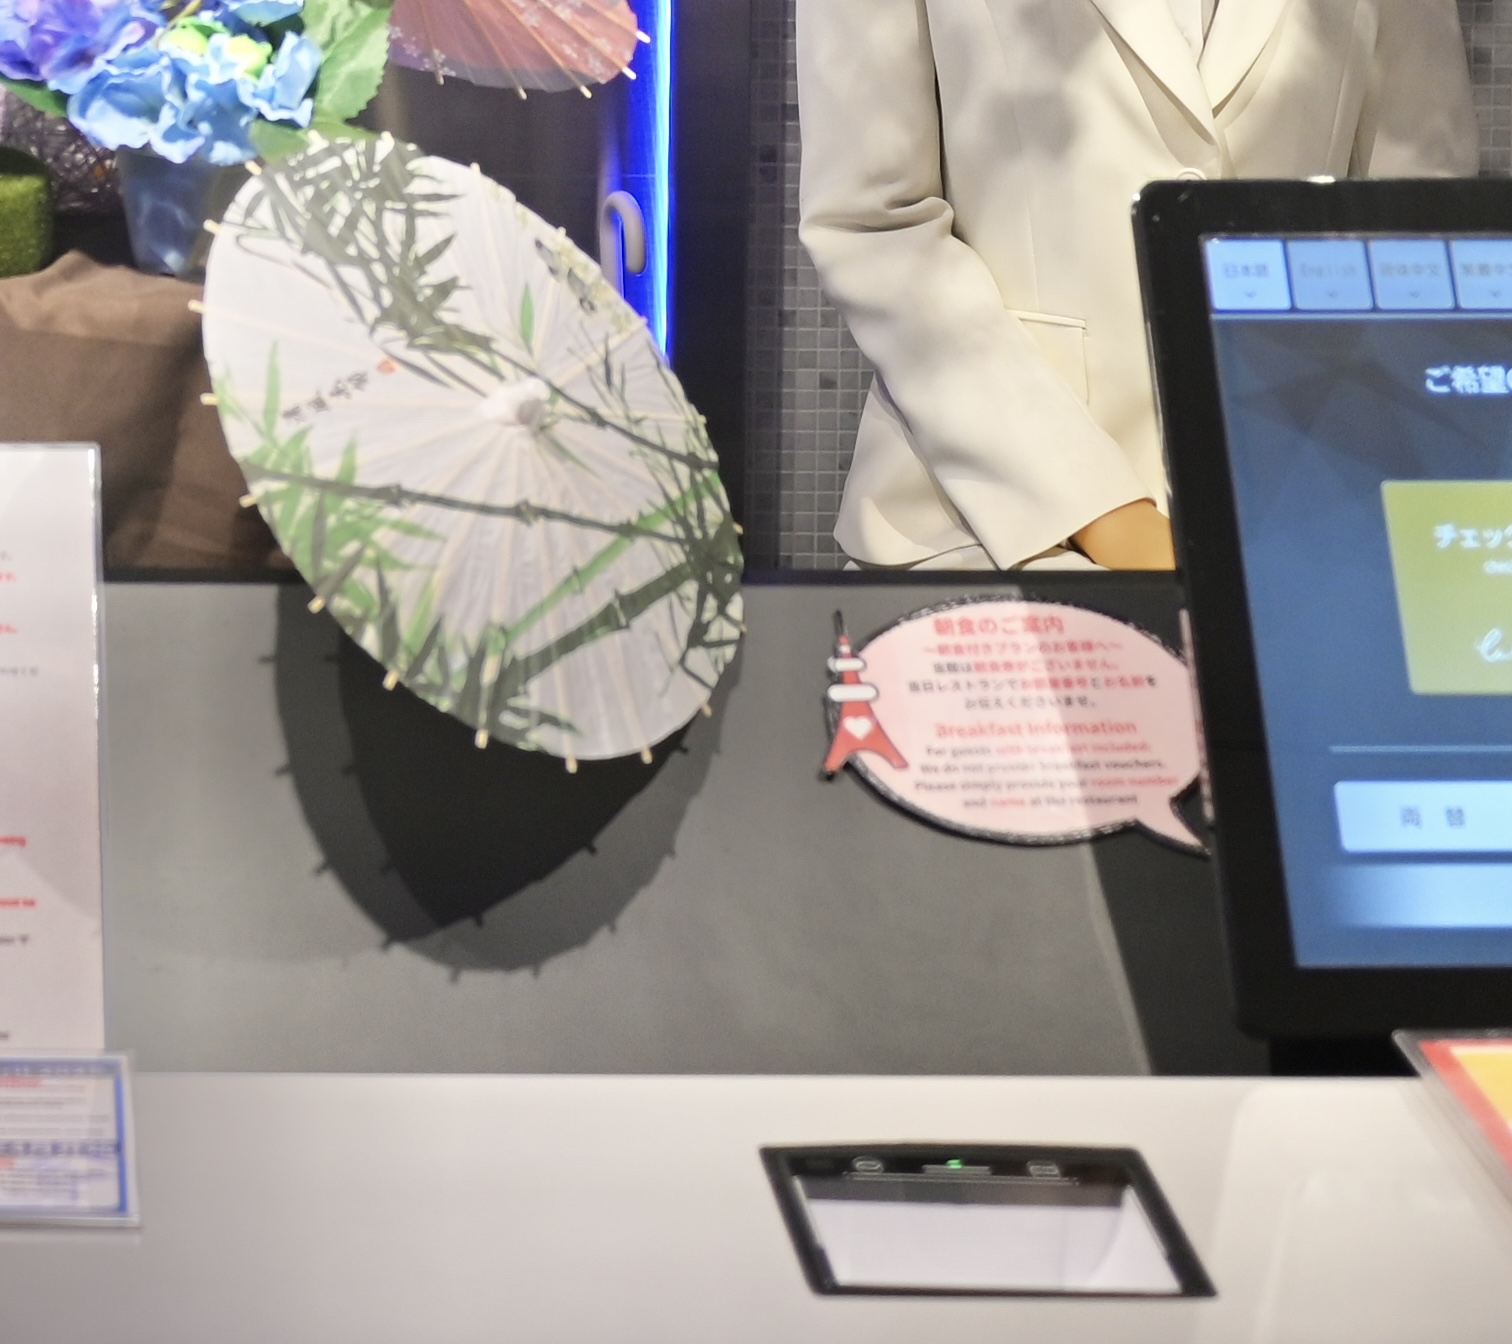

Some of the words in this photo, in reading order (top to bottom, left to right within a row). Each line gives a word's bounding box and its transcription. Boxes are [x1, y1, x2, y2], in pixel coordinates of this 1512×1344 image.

[934, 616, 1064, 635] 朝食のご案内
[935, 722, 1023, 738] Breakfast
[1028, 721, 1137, 737] Information
